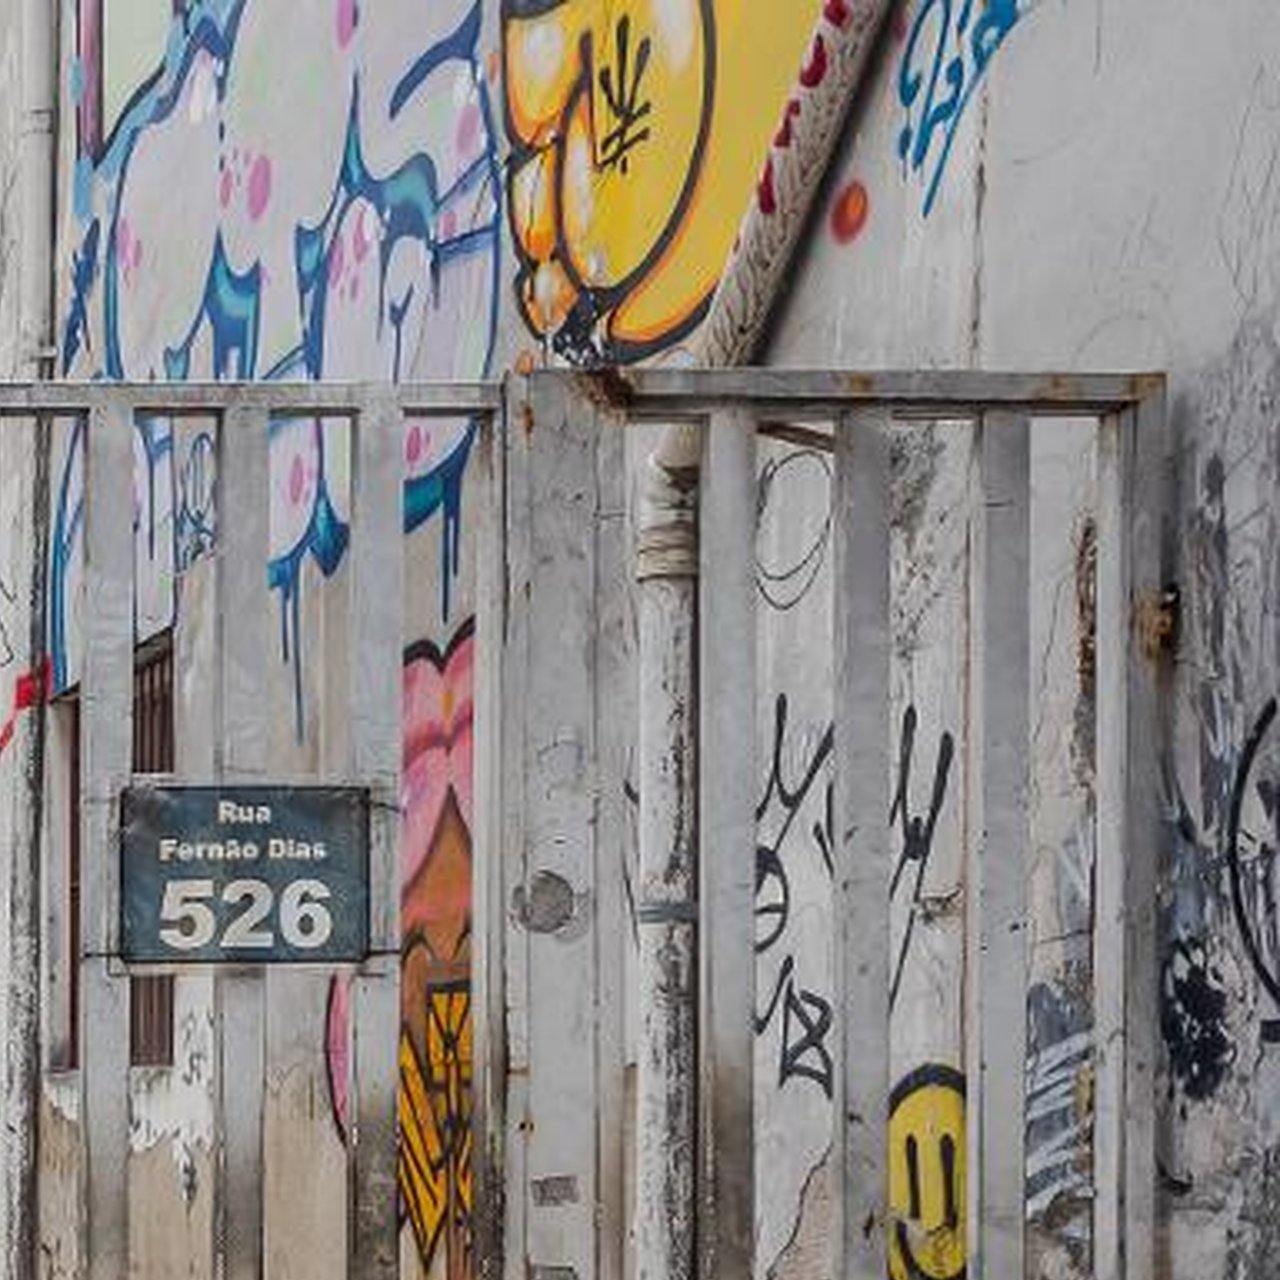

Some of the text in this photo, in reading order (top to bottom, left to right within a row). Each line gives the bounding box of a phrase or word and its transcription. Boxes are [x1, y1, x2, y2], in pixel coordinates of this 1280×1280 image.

[217, 800, 271, 824] Rua
[268, 838, 328, 860] Dias
[159, 879, 333, 949] 526
